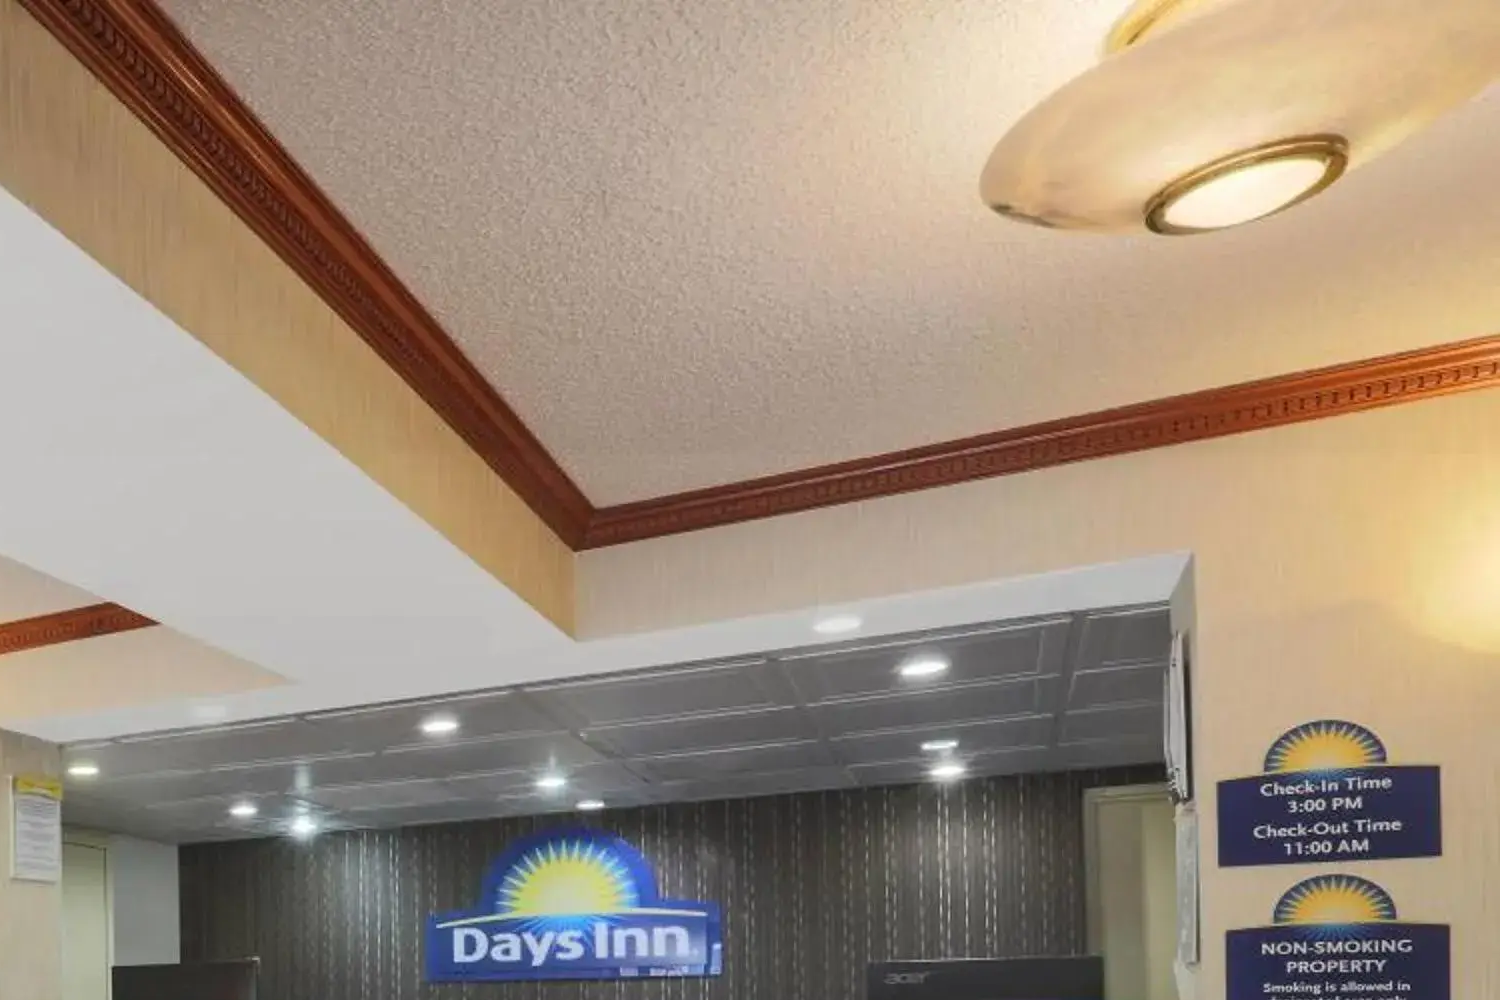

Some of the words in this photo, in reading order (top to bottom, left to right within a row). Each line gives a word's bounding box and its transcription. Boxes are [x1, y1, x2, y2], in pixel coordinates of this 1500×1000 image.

[1260, 777, 1338, 797] Check-In
[1346, 775, 1393, 792] Time
[1288, 799, 1327, 814] 3:00
[1332, 796, 1363, 811] PM
[1253, 820, 1349, 839] Check-Out
[1354, 818, 1402, 834] Time
[1284, 840, 1331, 856] 11:00
[1337, 838, 1369, 853] AM
[453, 926, 584, 967] Days
[593, 921, 690, 959] Inn
[1261, 939, 1413, 956] NON-SMOKING
[1286, 959, 1387, 974] PROPERTY
[1263, 982, 1321, 995] Smoking
[1325, 981, 1337, 993] is
[1340, 980, 1393, 993] allowed
[1397, 980, 1411, 992] in
